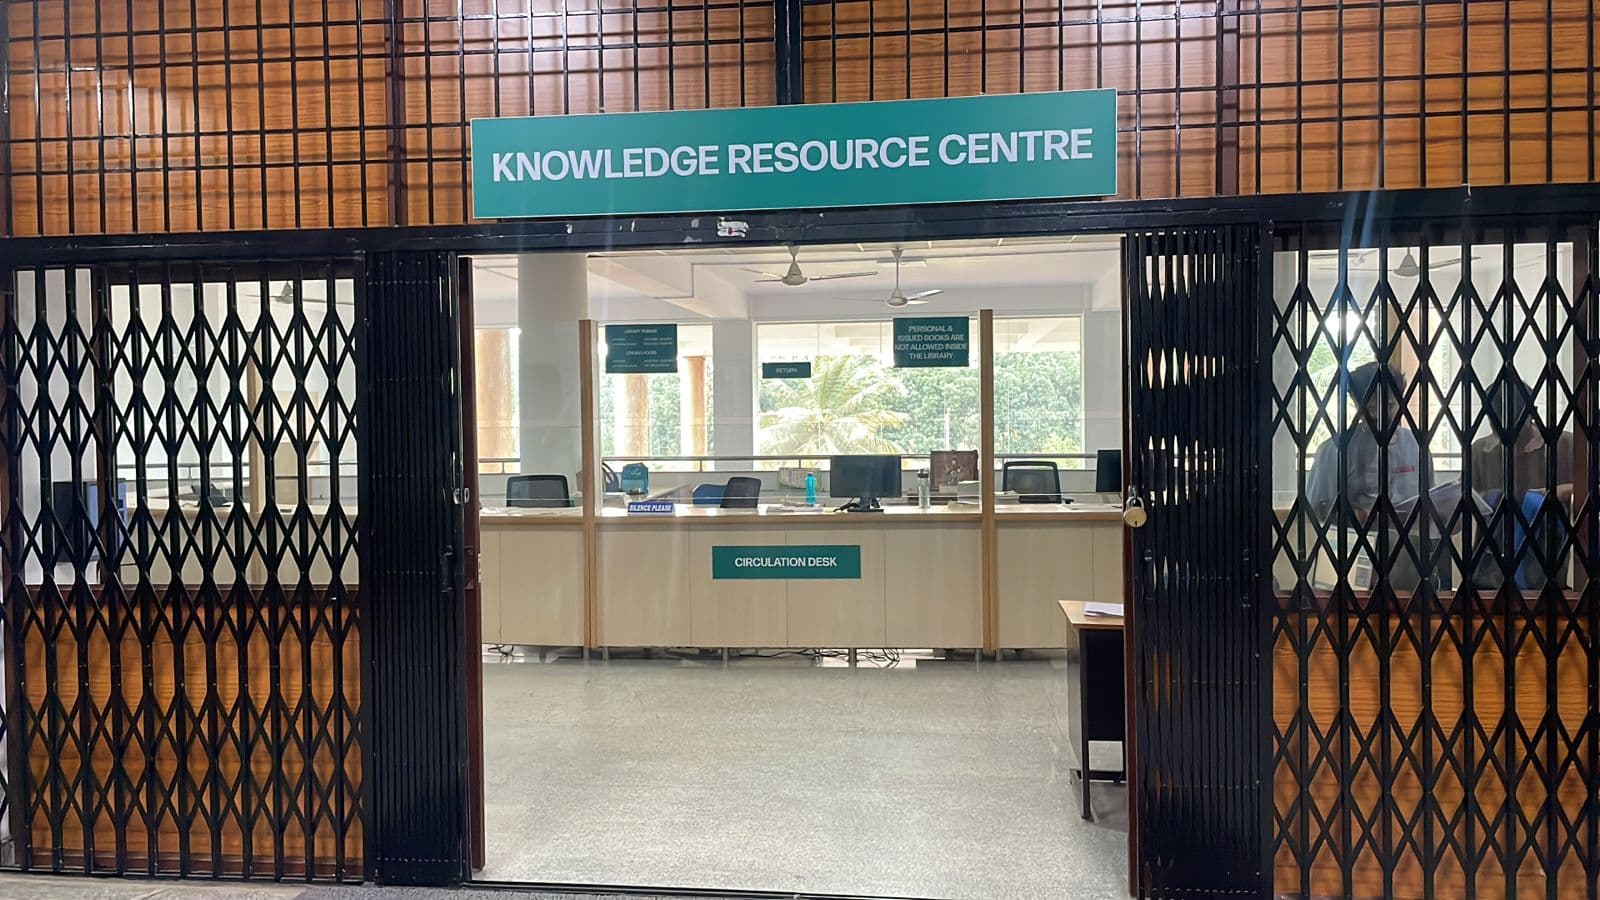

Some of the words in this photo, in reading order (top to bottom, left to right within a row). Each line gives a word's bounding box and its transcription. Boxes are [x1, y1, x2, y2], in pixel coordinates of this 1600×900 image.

[492, 145, 720, 183] KNOWLEDGE
[728, 135, 930, 174] RESOURCE
[938, 127, 1094, 165] CENTRE
[908, 325, 946, 333] PERSONAL
[897, 334, 923, 342] ISSUED
[950, 333, 966, 341] ARE
[895, 343, 910, 351] NOT
[924, 352, 954, 360] LIBRARY
[629, 504, 651, 512] SILENCE
[651, 504, 672, 512] PLEASE
[734, 556, 806, 568] CIRCULATION
[807, 556, 838, 567] DESK
